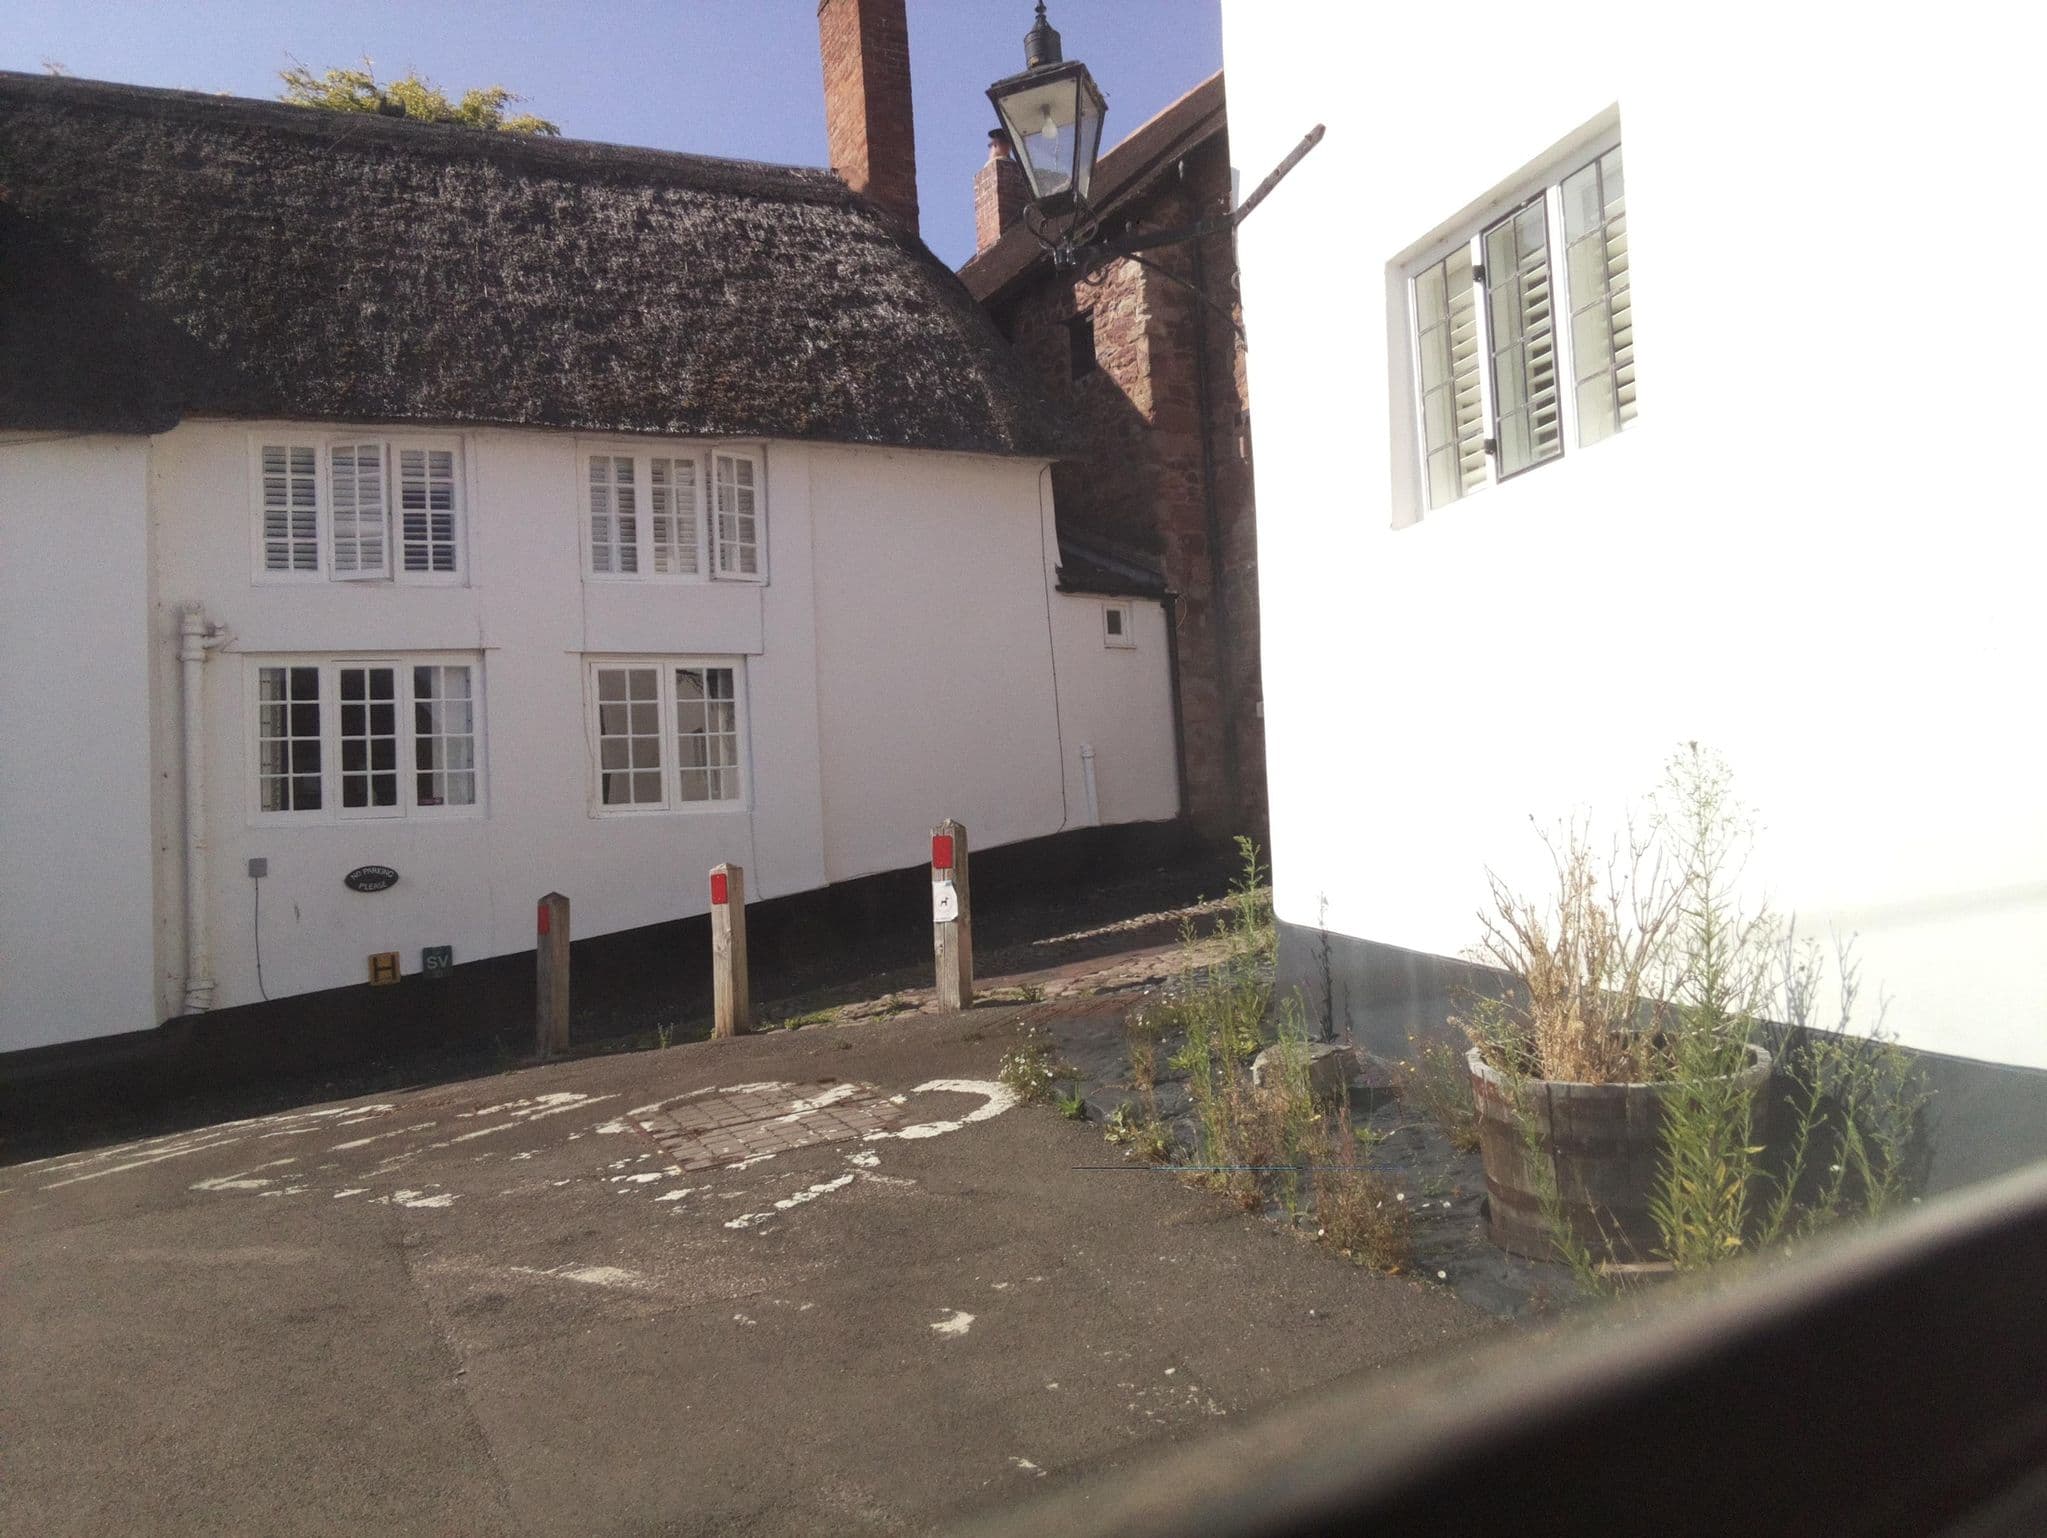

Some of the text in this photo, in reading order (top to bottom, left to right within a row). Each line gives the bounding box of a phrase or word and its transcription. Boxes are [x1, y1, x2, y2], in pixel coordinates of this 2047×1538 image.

[350, 866, 395, 880] NO PARKING
[358, 881, 387, 891] PLEASE
[372, 953, 396, 982] H
[426, 954, 449, 970] SV
